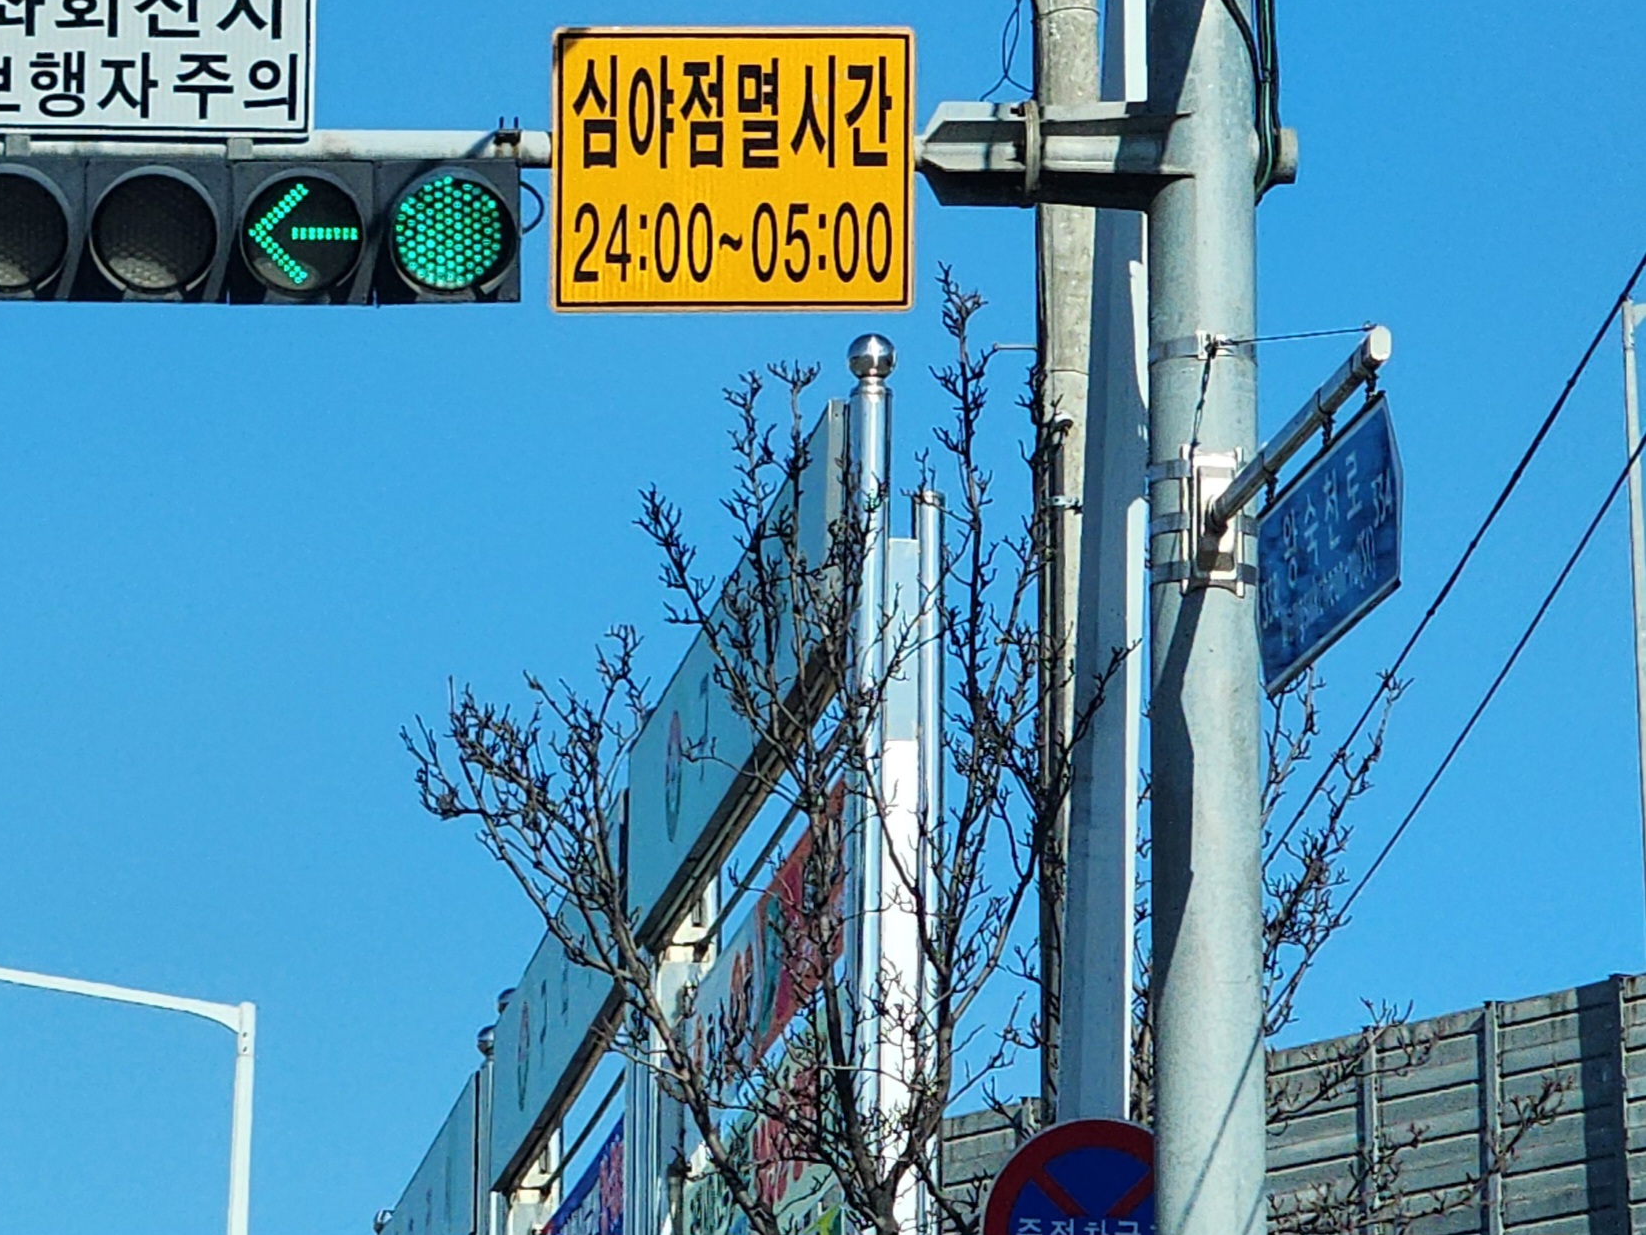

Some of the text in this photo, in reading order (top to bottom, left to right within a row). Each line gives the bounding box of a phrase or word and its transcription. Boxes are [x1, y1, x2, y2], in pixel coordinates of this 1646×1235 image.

[572, 54, 893, 169] 심야점멸시간
[572, 202, 893, 284] 24:00~05:00
[1016, 1217, 1157, 1235] 주정차금
